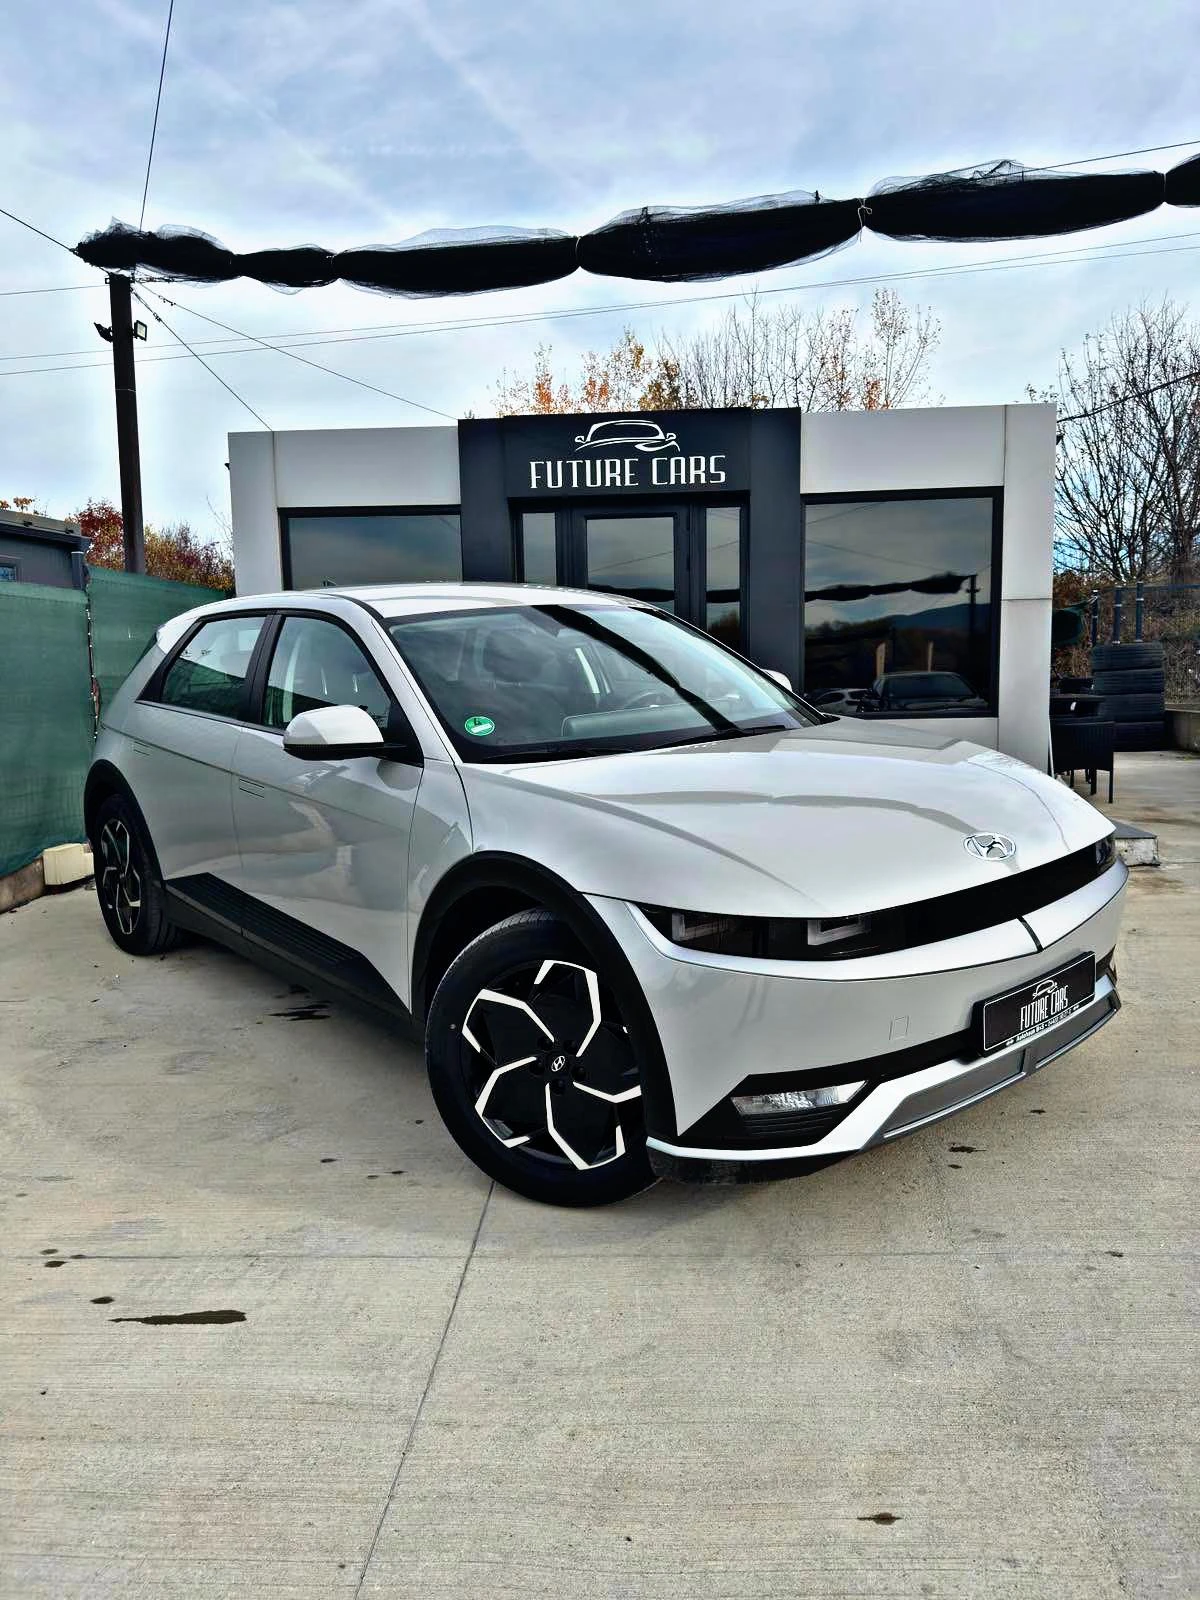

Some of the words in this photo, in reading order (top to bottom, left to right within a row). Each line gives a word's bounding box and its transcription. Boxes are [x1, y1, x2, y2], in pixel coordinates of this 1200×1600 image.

[529, 458, 639, 489] FUTURE
[652, 455, 726, 485] CARS
[1020, 996, 1049, 1031] FUTURE
[1050, 985, 1068, 1017] CARS
